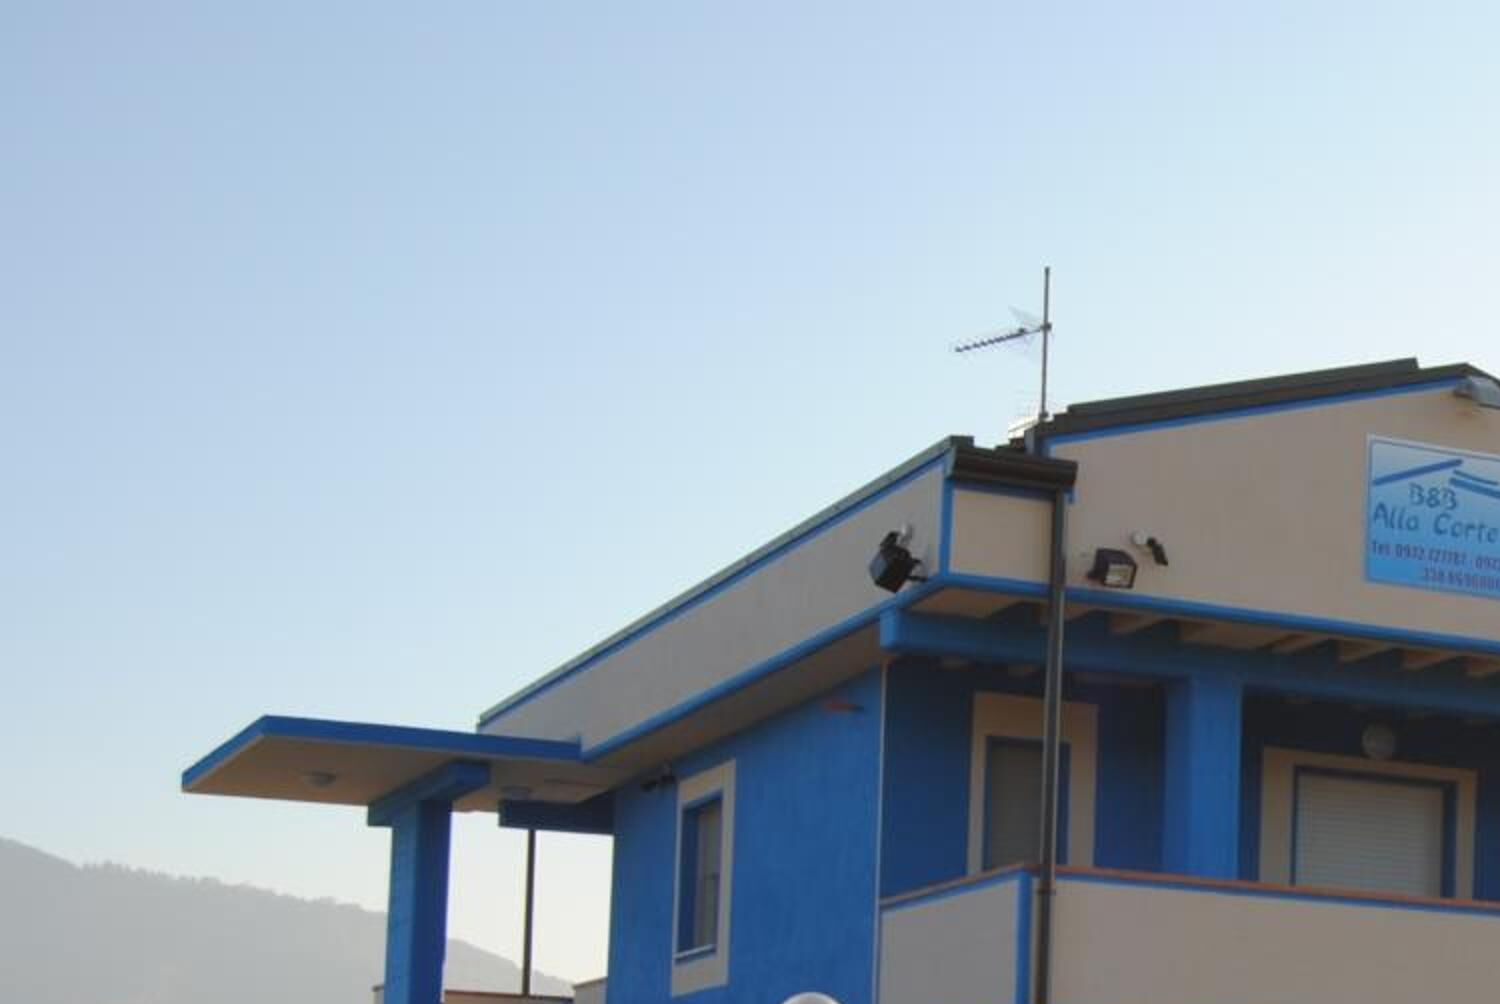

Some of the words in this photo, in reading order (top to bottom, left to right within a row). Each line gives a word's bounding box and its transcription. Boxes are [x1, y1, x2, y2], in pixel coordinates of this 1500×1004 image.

[1408, 483, 1458, 511] B&B
[1373, 502, 1420, 532] Alla
[1433, 513, 1500, 543] Corte
